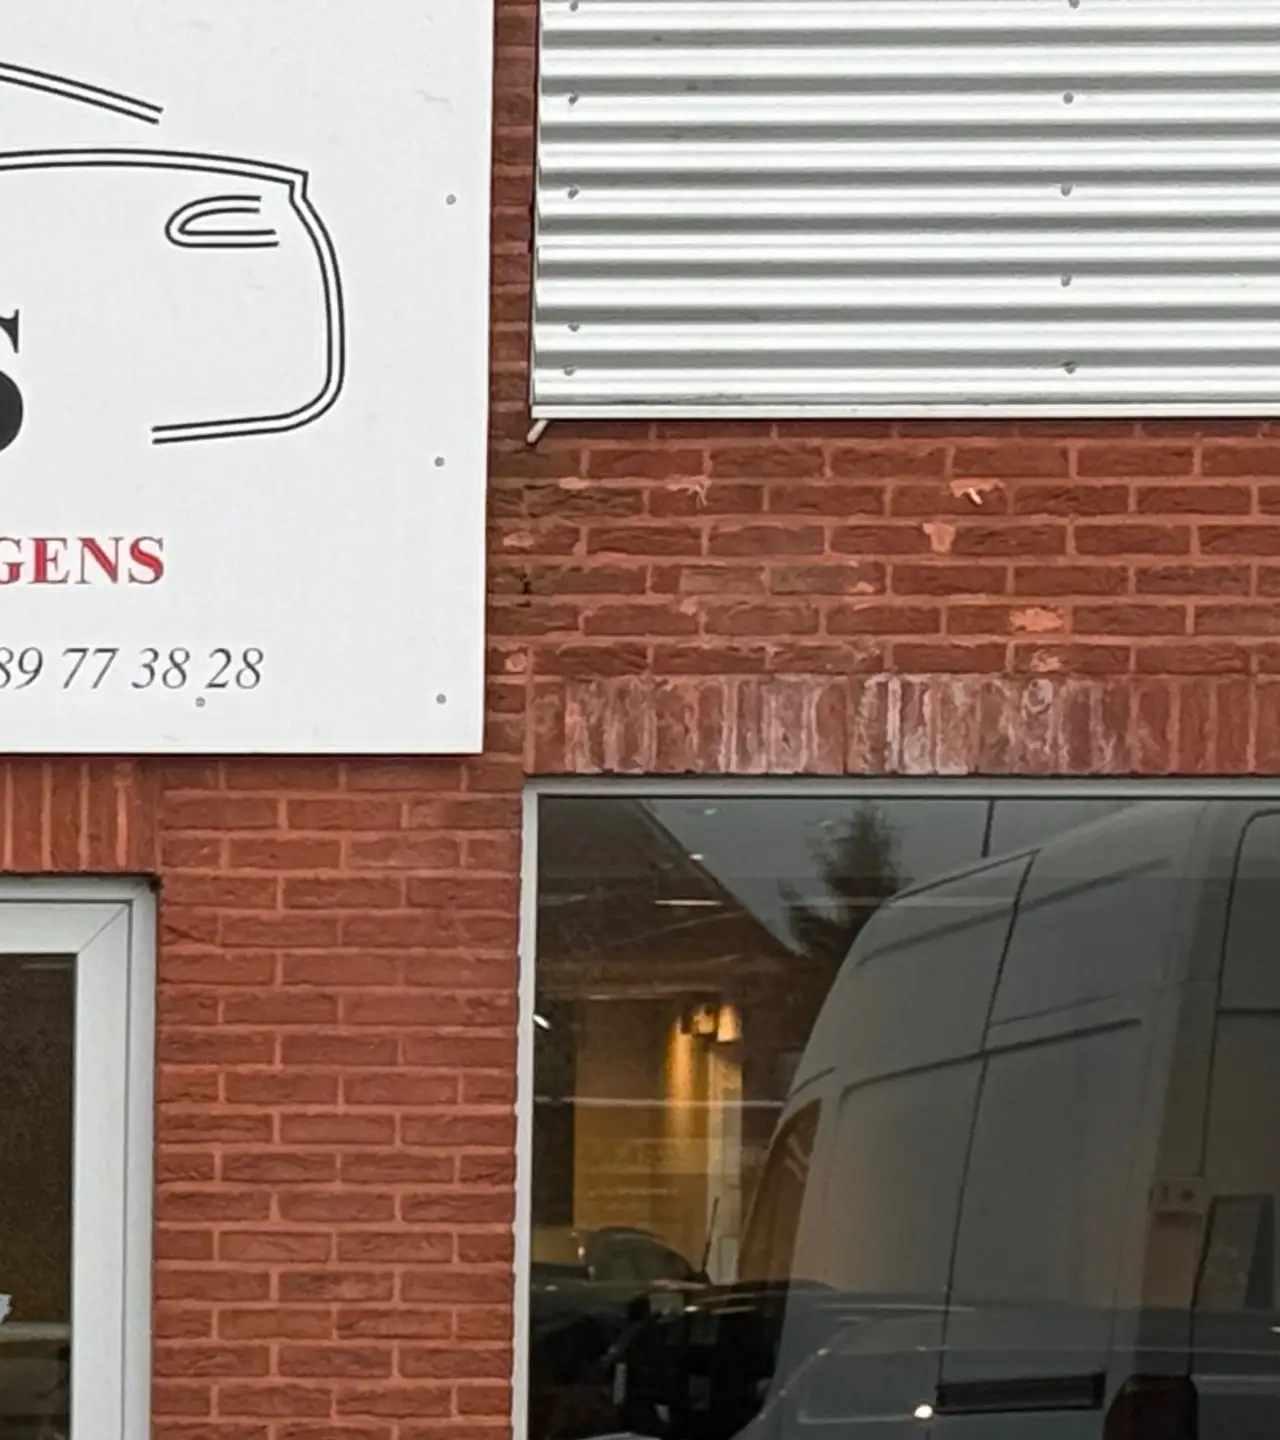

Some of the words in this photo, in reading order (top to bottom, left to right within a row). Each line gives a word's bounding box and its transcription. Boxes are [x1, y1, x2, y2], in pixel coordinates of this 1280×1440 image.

[63, 647, 121, 690] 77
[132, 647, 192, 690] 38
[205, 647, 265, 690] 28
